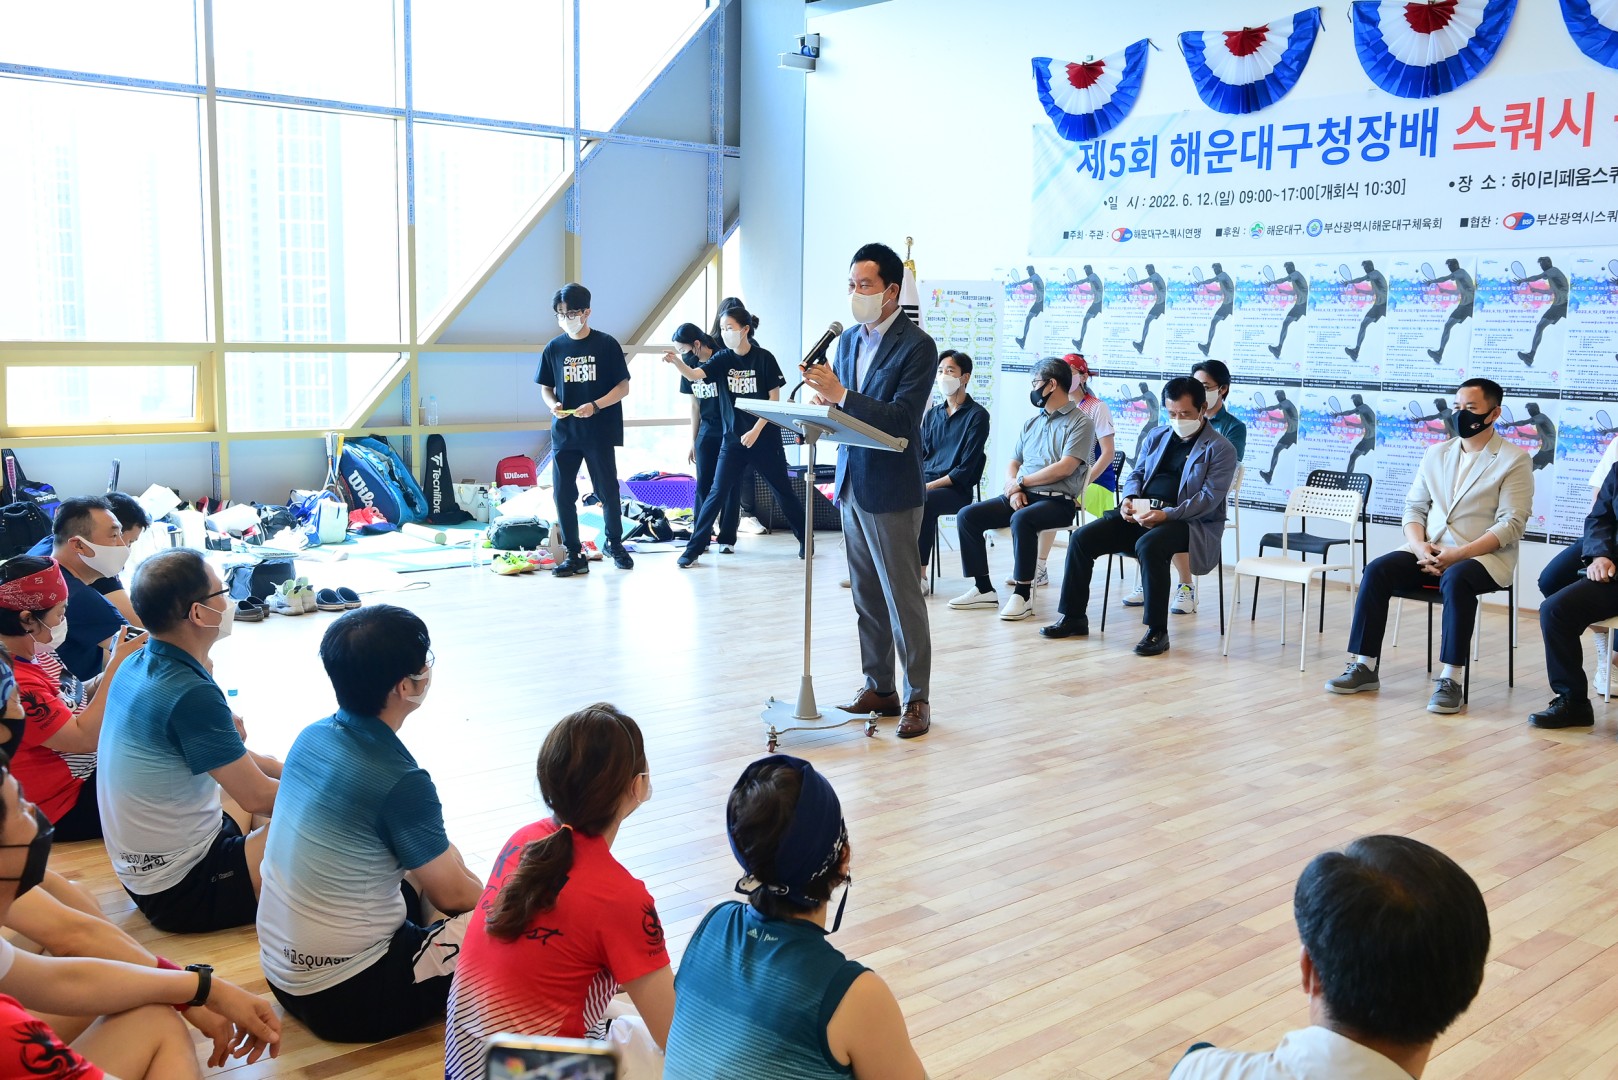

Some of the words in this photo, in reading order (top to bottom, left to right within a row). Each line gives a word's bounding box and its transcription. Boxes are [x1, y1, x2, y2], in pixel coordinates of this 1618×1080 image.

[1076, 134, 1158, 180] 제5회
[1170, 107, 1440, 176] 해운대구청장배
[1453, 92, 1595, 151] 스쿼시
[1458, 174, 1473, 193] 장
[1480, 174, 1496, 190] 소
[1108, 196, 1118, 210] 일
[1323, 217, 1442, 234] 부산광역시해운대구체육회
[1470, 215, 1491, 229] 협찬
[563, 364, 597, 383] FRESH
[691, 381, 719, 399] FRESH
[727, 376, 758, 394] FRESH
[503, 472, 530, 480] Wilson
